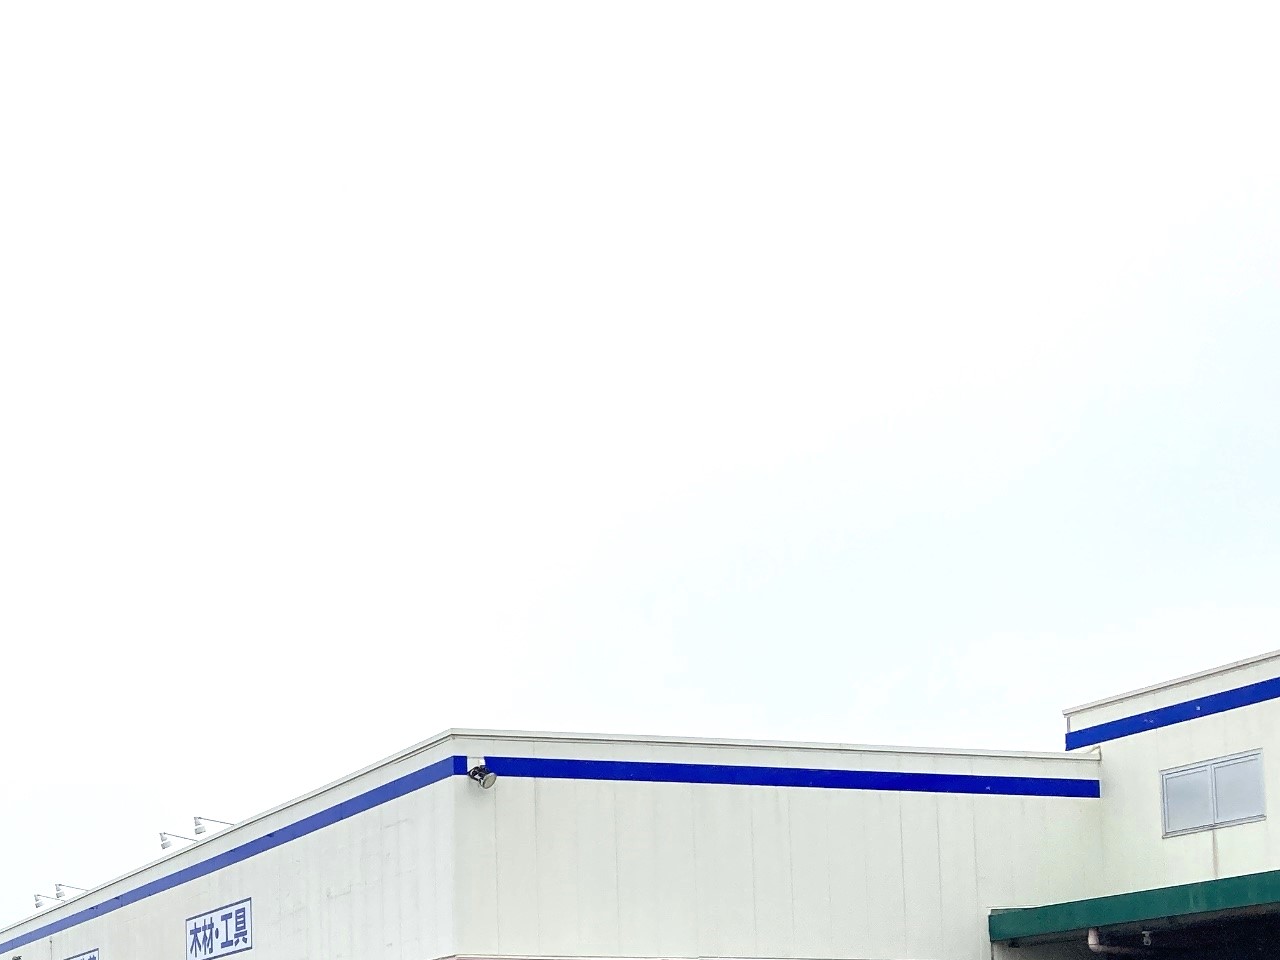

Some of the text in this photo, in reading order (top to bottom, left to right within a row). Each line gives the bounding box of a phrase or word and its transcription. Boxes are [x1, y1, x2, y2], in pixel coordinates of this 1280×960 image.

[189, 907, 248, 958] 木材・工具
